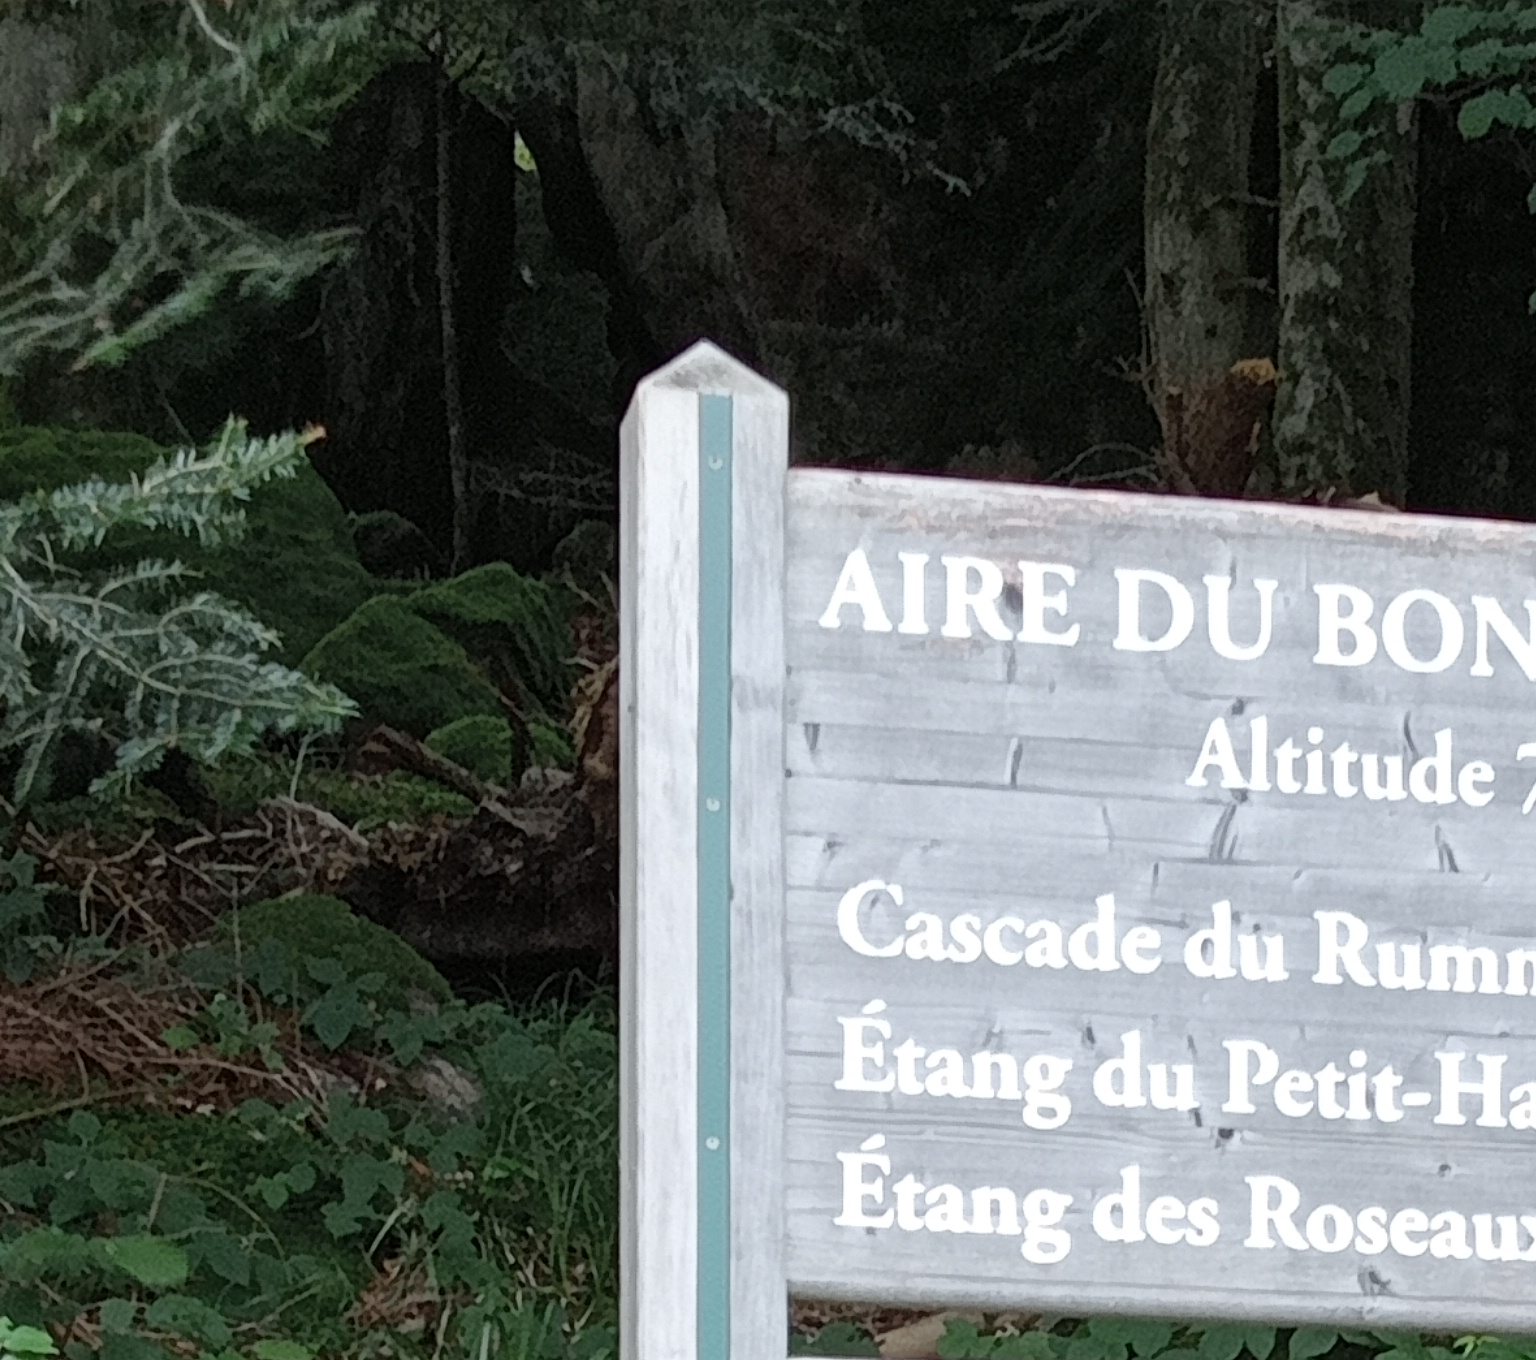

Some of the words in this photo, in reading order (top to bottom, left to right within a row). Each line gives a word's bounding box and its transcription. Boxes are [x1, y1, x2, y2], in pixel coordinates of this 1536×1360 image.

[818, 547, 1081, 647] AIRE
[1112, 568, 1279, 661] DU
[1185, 715, 1495, 807] Altitude
[836, 879, 1162, 974] Cascade
[1183, 899, 1289, 982] du
[834, 998, 1074, 1130] Étang
[1092, 1028, 1200, 1112] du
[833, 1133, 1074, 1264] Étang
[1092, 1163, 1221, 1247] des
